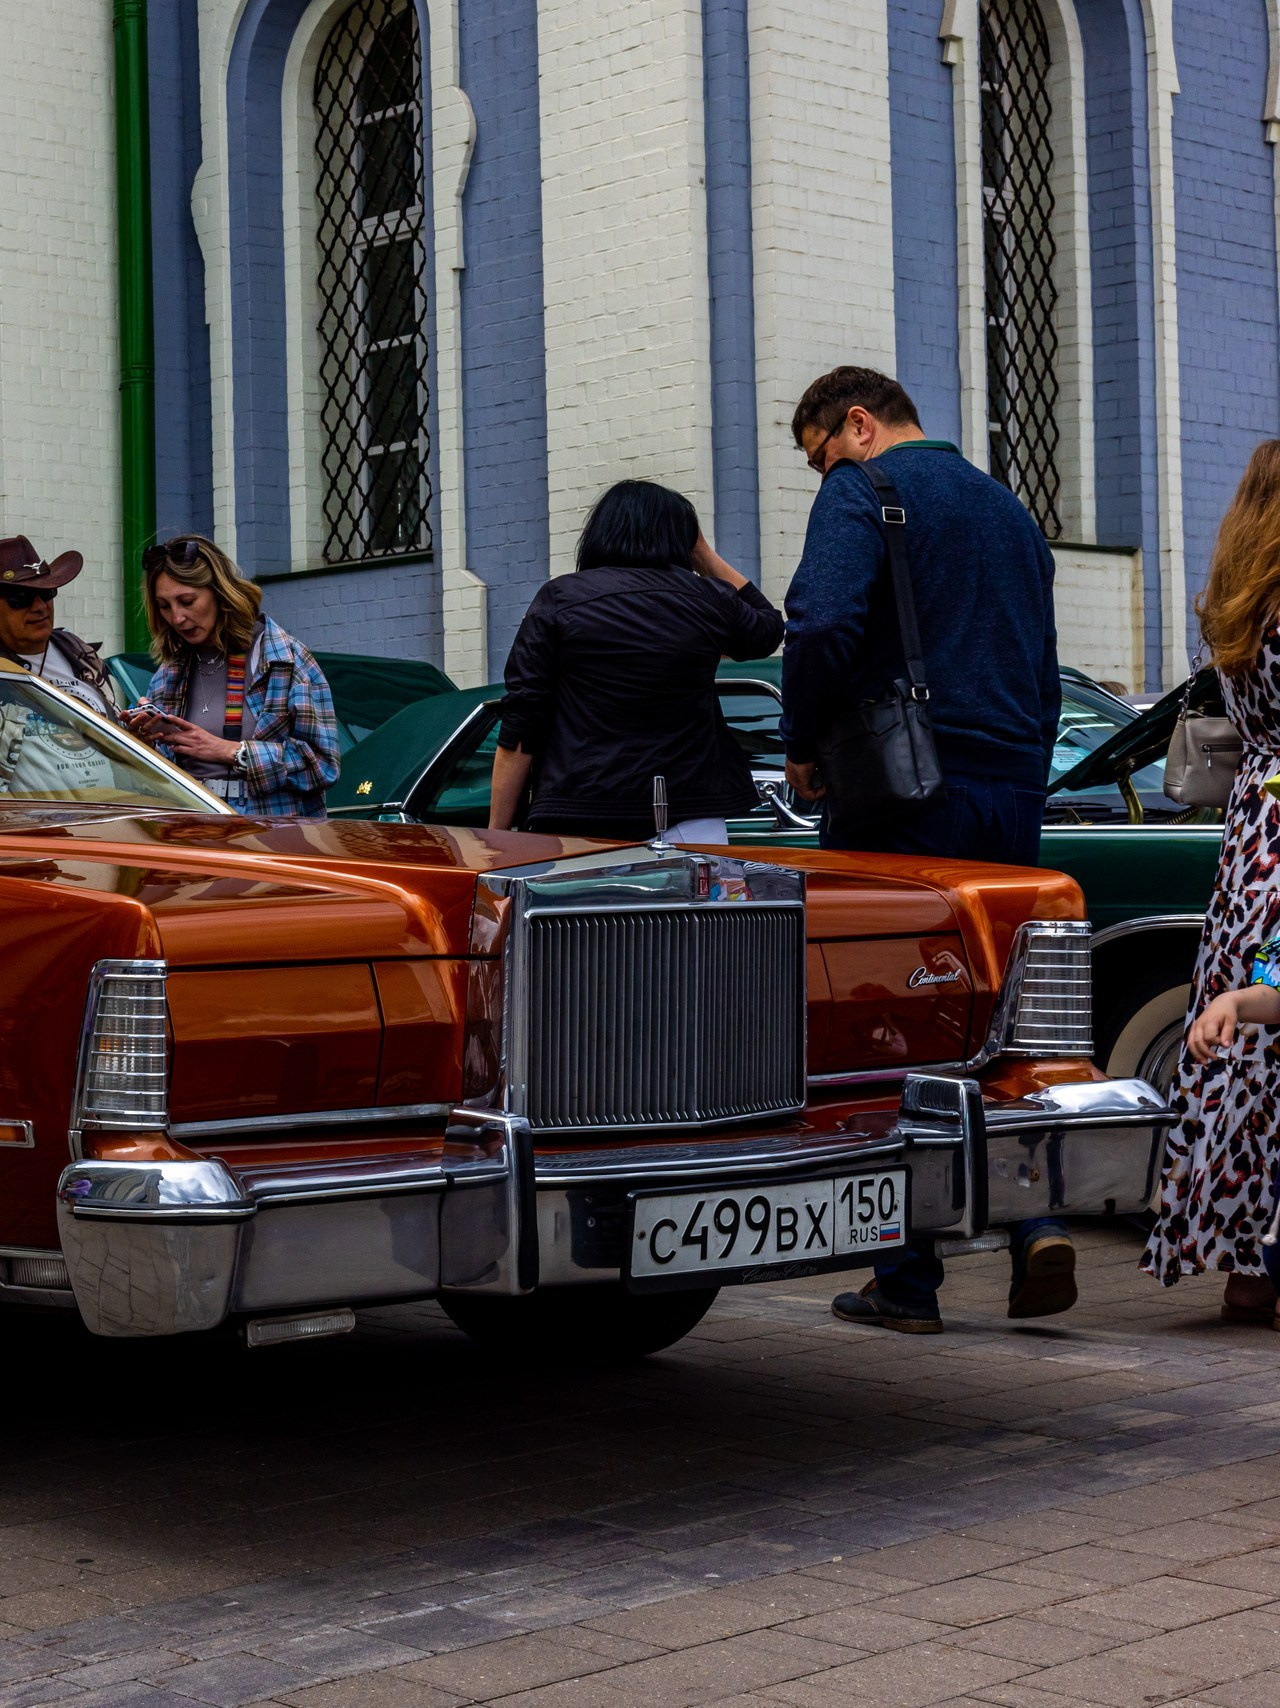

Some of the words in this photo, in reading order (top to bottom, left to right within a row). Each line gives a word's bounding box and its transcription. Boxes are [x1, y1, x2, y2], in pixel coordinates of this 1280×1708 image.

[909, 966, 961, 988] Continental
[840, 1176, 896, 1226] 150
[849, 1226, 878, 1244] RUS
